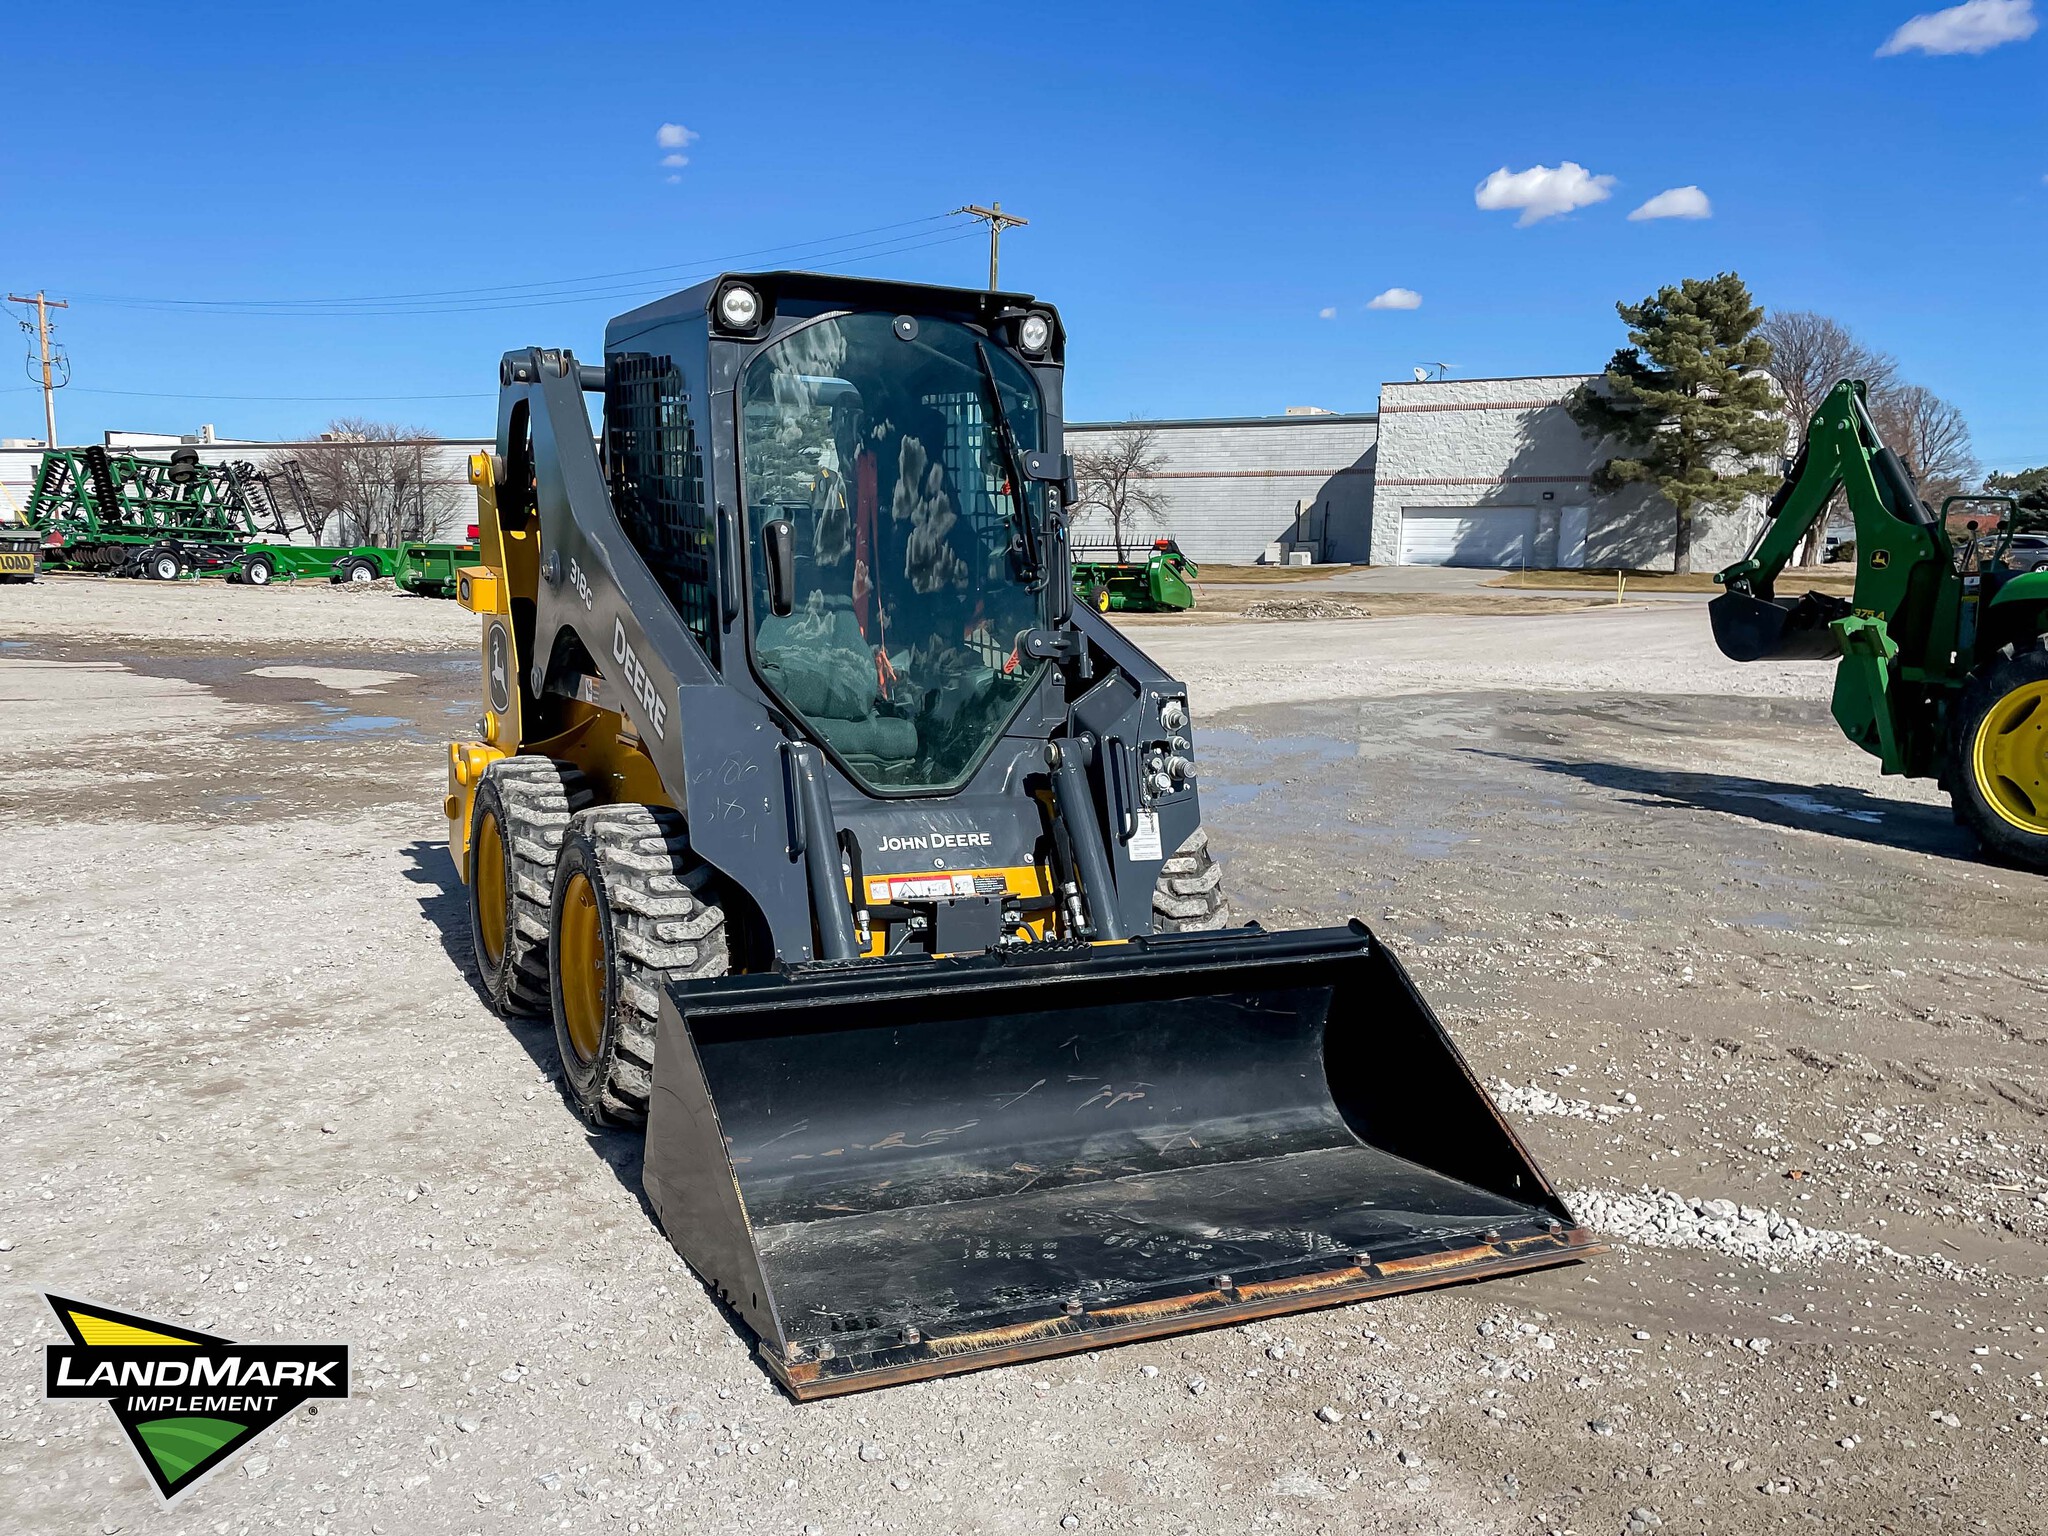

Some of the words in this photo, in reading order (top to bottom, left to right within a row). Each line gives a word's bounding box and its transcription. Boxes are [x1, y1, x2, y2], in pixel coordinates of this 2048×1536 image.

[569, 557, 593, 611] 318G
[613, 616, 667, 740] DEERE
[878, 835, 928, 852] JOHN
[930, 832, 992, 849] DEERE
